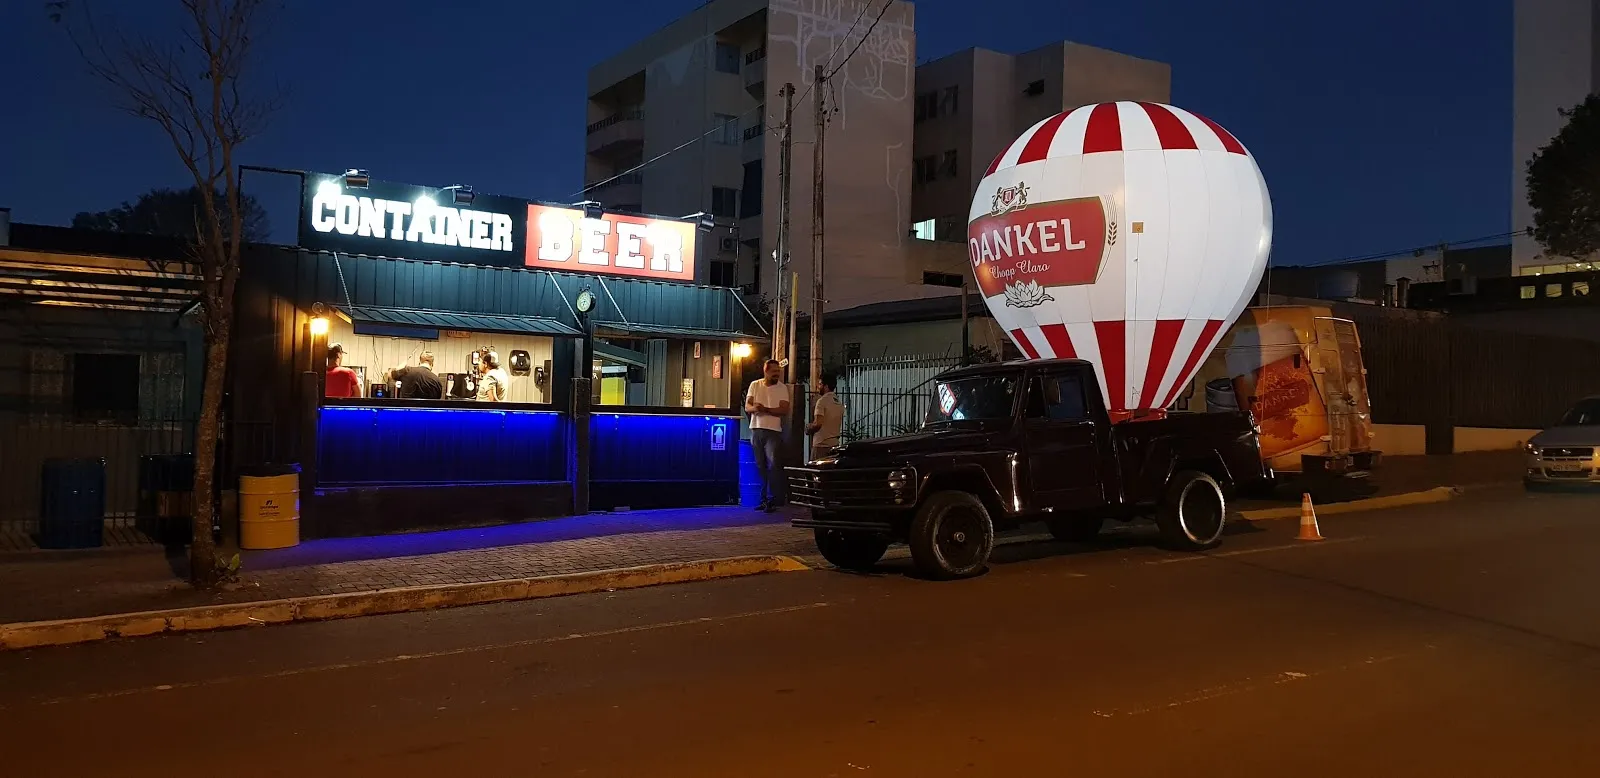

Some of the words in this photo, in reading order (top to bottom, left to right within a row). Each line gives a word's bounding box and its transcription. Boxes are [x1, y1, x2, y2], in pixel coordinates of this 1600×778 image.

[311, 194, 513, 251] CONTAINER
[538, 211, 684, 273] BEER
[970, 218, 1086, 267] DANKEL
[989, 266, 1016, 280] Chopp
[1016, 259, 1050, 274] Claro
